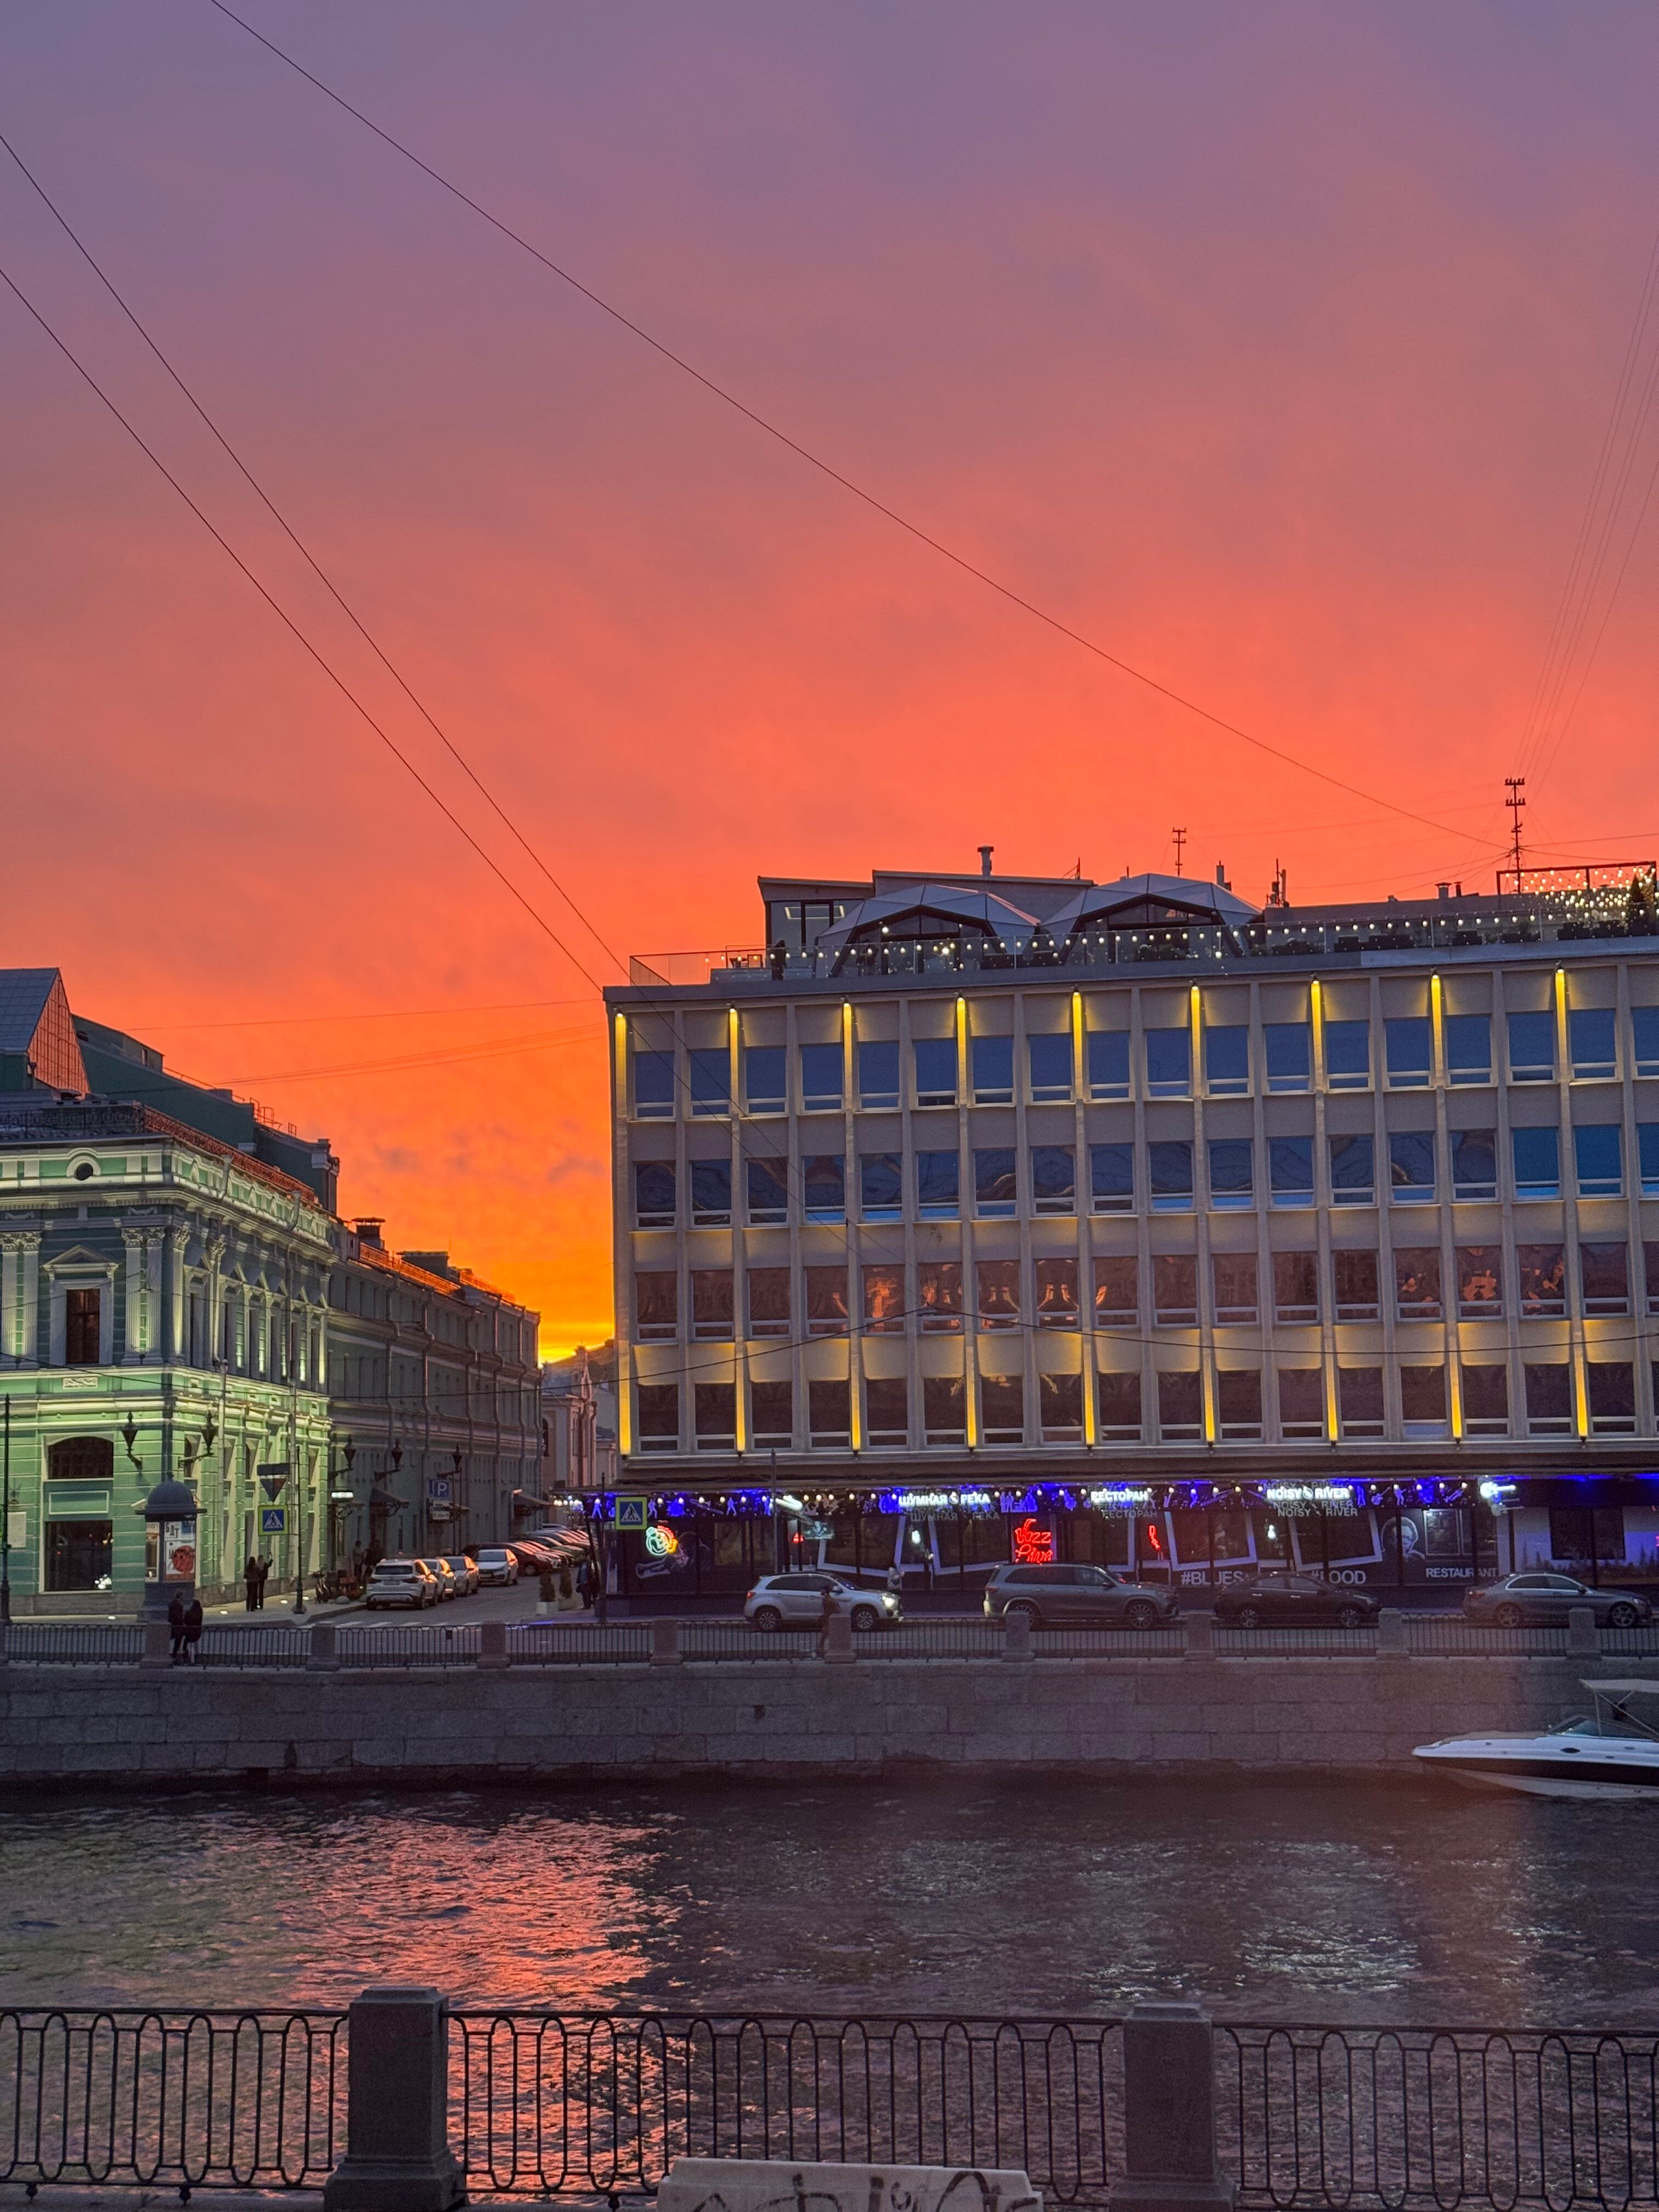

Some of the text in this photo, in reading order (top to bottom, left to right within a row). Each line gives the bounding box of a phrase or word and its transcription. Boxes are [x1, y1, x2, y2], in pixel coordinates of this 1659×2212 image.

[438, 1482, 447, 1496] P
[1267, 1488, 1350, 1499] NOISY RIVER
[899, 1493, 991, 1506] ШУМНАЯ РЕКА
[1091, 1491, 1148, 1502] РЕСТОРАН
